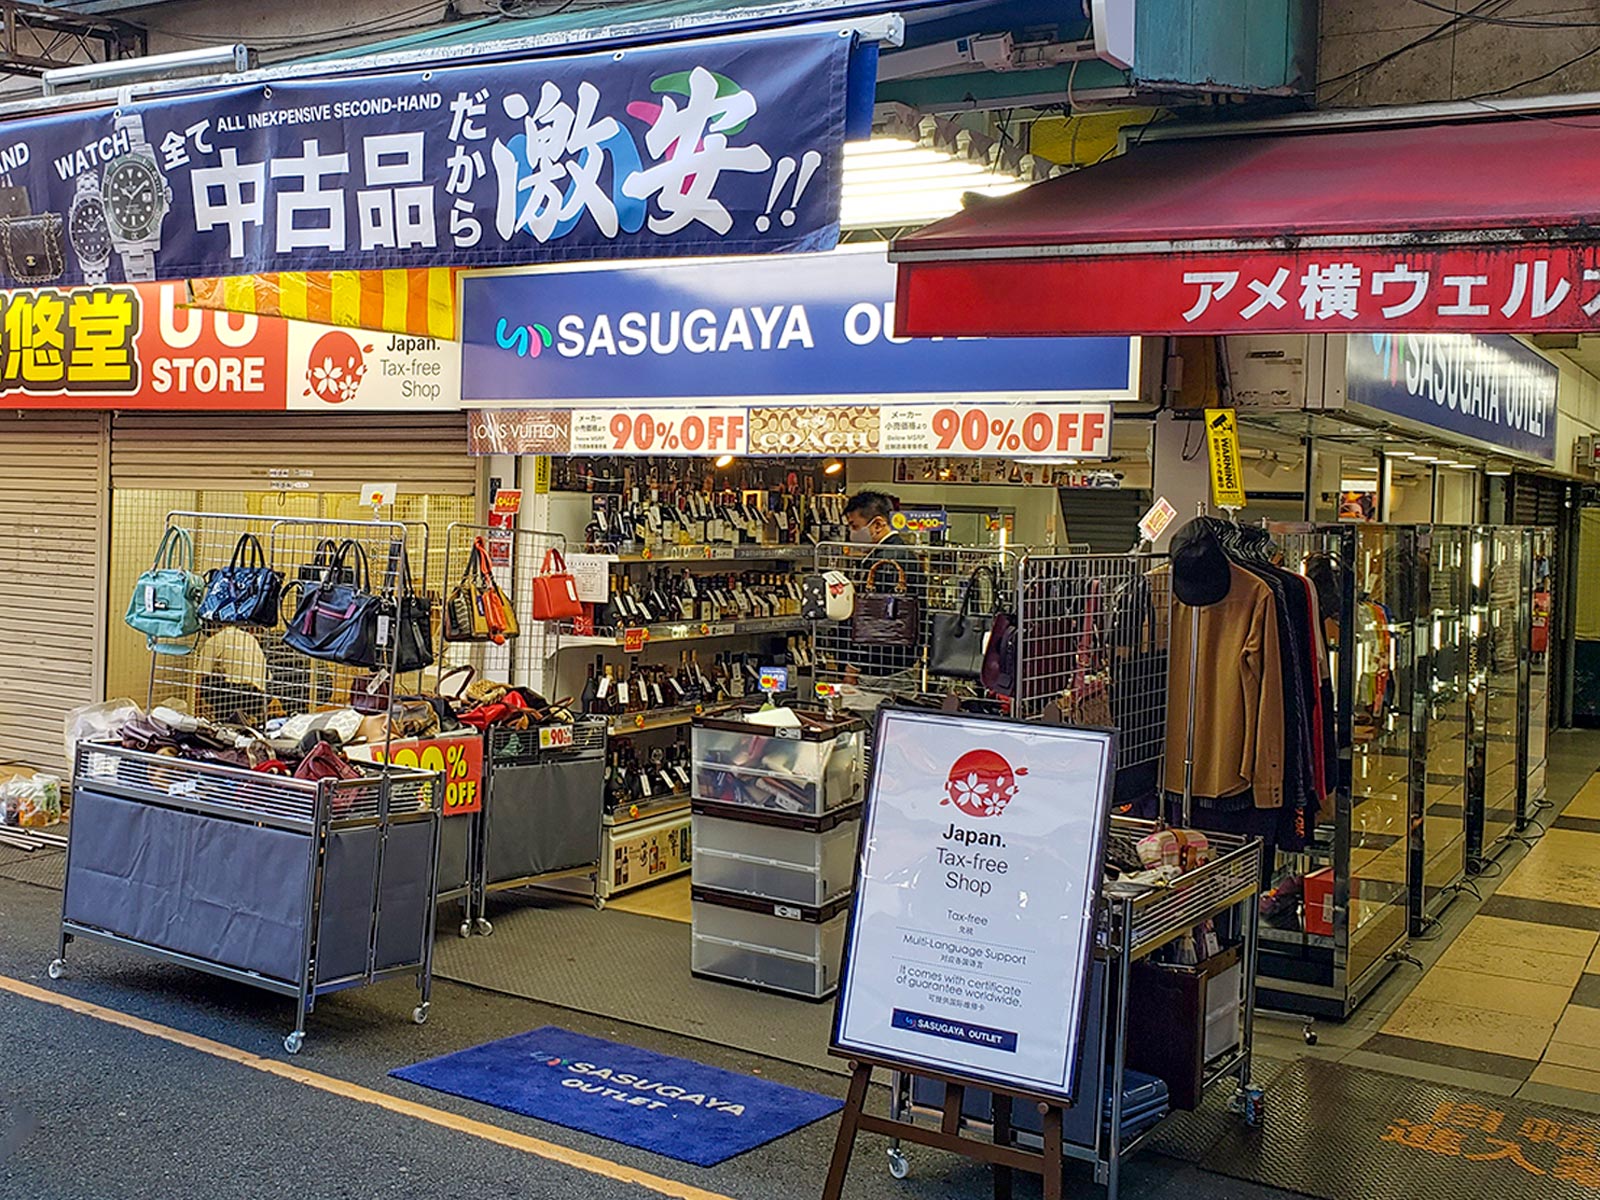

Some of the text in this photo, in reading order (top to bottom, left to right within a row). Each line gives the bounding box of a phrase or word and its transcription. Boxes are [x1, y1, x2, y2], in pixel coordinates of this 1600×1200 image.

[217, 93, 442, 132] ALL INEXPENSIVE SECOND-HAND
[0, 142, 30, 173] ND
[54, 130, 130, 181] WATCH
[158, 118, 215, 170] 全て
[444, 87, 491, 248] だから
[191, 131, 436, 258] 中古品
[0, 292, 132, 382] 悠堂
[386, 334, 441, 354] Japan.
[556, 305, 814, 358] SASUGAYA
[152, 357, 265, 393] STORE
[380, 359, 441, 377] Tax-free
[402, 380, 441, 400] Shop
[1406, 334, 1547, 438] SASUGAYA OUTLET
[759, 431, 867, 449] COACH
[1221, 437, 1234, 489] WARNING
[446, 781, 477, 807] OFF
[942, 823, 1007, 849] Japan.
[936, 847, 1009, 875] Tax-free
[944, 872, 992, 897] Shop
[947, 909, 988, 926] Tax-free
[903, 935, 1027, 965] Multi-Language Support
[896, 974, 1023, 1008] of guarantee worldwide.
[899, 965, 1022, 998] It comes with certificate
[917, 1019, 1003, 1045] SASUGAYA OUTLET
[561, 1078, 668, 1112] OUTLET
[567, 1062, 746, 1117] SASUGAYA
